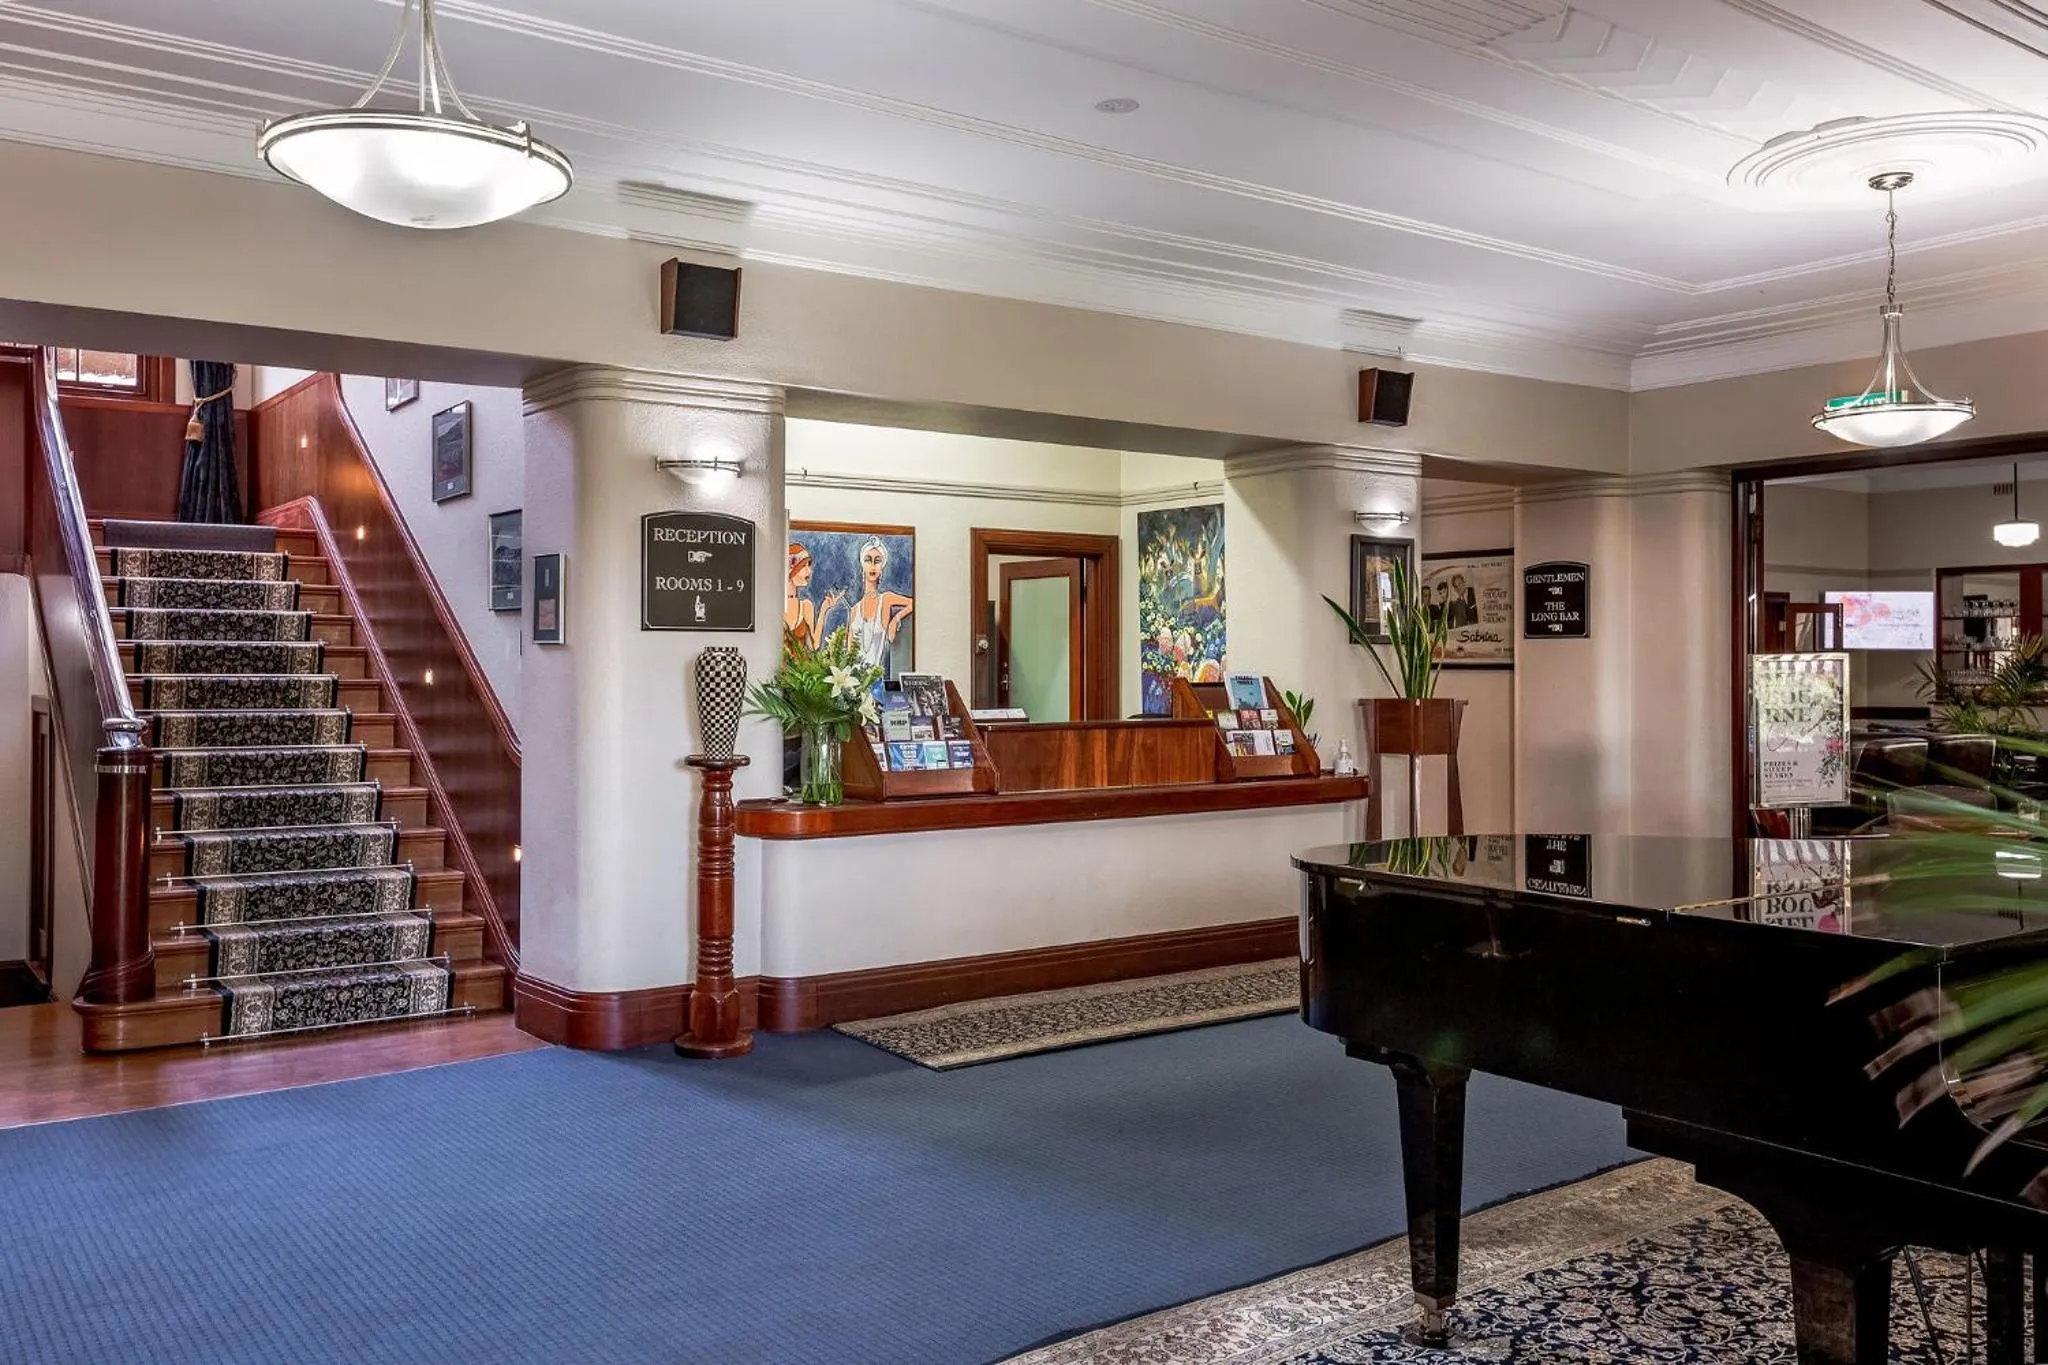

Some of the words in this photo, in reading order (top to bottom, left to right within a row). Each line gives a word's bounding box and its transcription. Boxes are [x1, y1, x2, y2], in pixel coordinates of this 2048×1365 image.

[653, 527, 746, 545] RECEPTION
[655, 576, 713, 591] ROOMS
[1525, 572, 1585, 584] GENTLEMEN
[1544, 601, 1566, 611] THE
[1531, 612, 1558, 622] LONG
[1559, 611, 1580, 621] BAR
[1456, 630, 1505, 643] Sabrina
